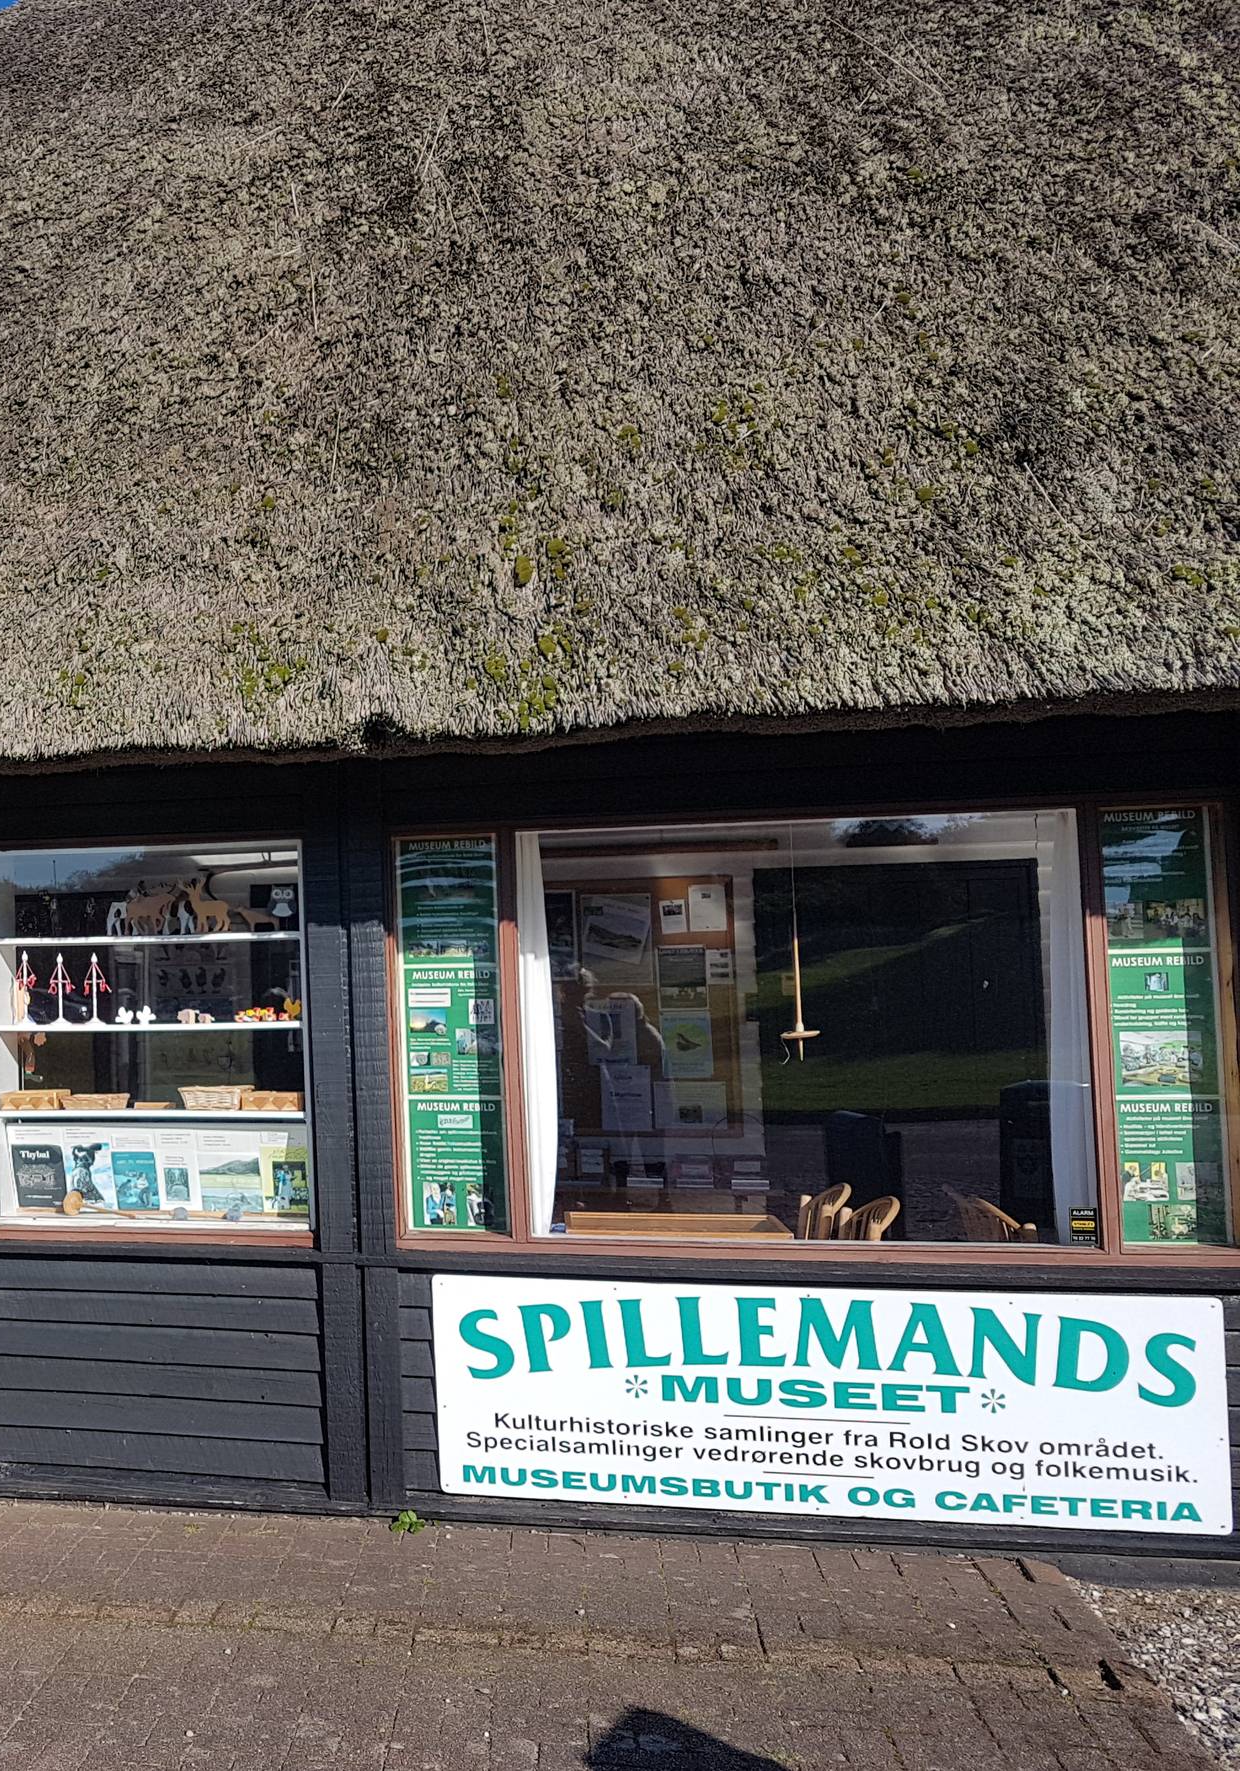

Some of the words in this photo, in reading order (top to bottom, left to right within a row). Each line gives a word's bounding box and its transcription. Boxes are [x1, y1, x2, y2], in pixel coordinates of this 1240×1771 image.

[1104, 811, 1154, 822] MUSEUM
[408, 841, 451, 850] MUSEUM
[453, 839, 486, 849] REBILD
[1111, 957, 1163, 967] MUSEUM
[1166, 956, 1204, 966] REBILD
[412, 970, 455, 979] MUSEUM
[458, 970, 490, 979] REBILD
[416, 1102, 460, 1111] MUSEUM
[463, 1102, 496, 1111] REBILD
[1120, 1103, 1171, 1112] MUSEUM
[1174, 1102, 1213, 1112] REBILD
[458, 1296, 1197, 1408] SPILLEMANDS
[660, 1374, 971, 1415] MUSEET
[493, 1412, 695, 1439] Kulturhistoriske
[704, 1424, 835, 1448] samlinger
[843, 1428, 879, 1448] fra
[888, 1430, 951, 1450] Rold
[961, 1433, 1029, 1454] Skov
[1038, 1437, 1165, 1460] området.
[465, 1431, 684, 1462] Specialsamlinger
[692, 1444, 844, 1467] vedrørende
[853, 1451, 981, 1478] skovbrug
[990, 1461, 1026, 1480] og
[1035, 1459, 1200, 1484] folkemusik.
[461, 1464, 832, 1504] MUSEUMSBUTIK
[847, 1486, 916, 1509] OG
[934, 1490, 1203, 1523] CAFETERIA
